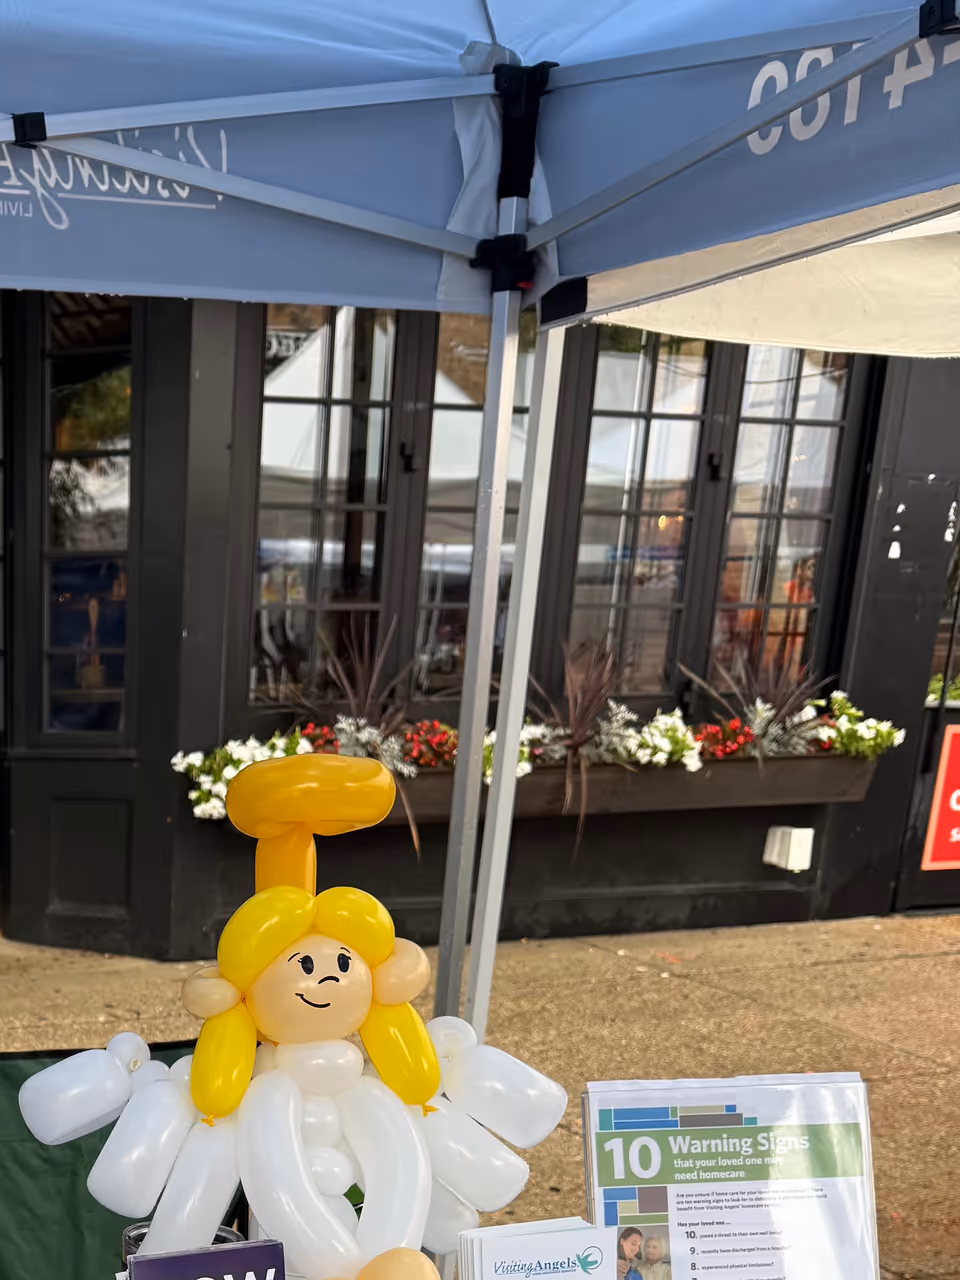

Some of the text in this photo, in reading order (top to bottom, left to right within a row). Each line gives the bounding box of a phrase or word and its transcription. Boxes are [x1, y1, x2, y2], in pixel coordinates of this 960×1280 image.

[604, 1133, 809, 1179] 10 Warning Signs
[674, 1159, 693, 1168] that
[695, 1158, 717, 1169] your
[719, 1156, 742, 1166] loved
[675, 1170, 745, 1180] need homecare
